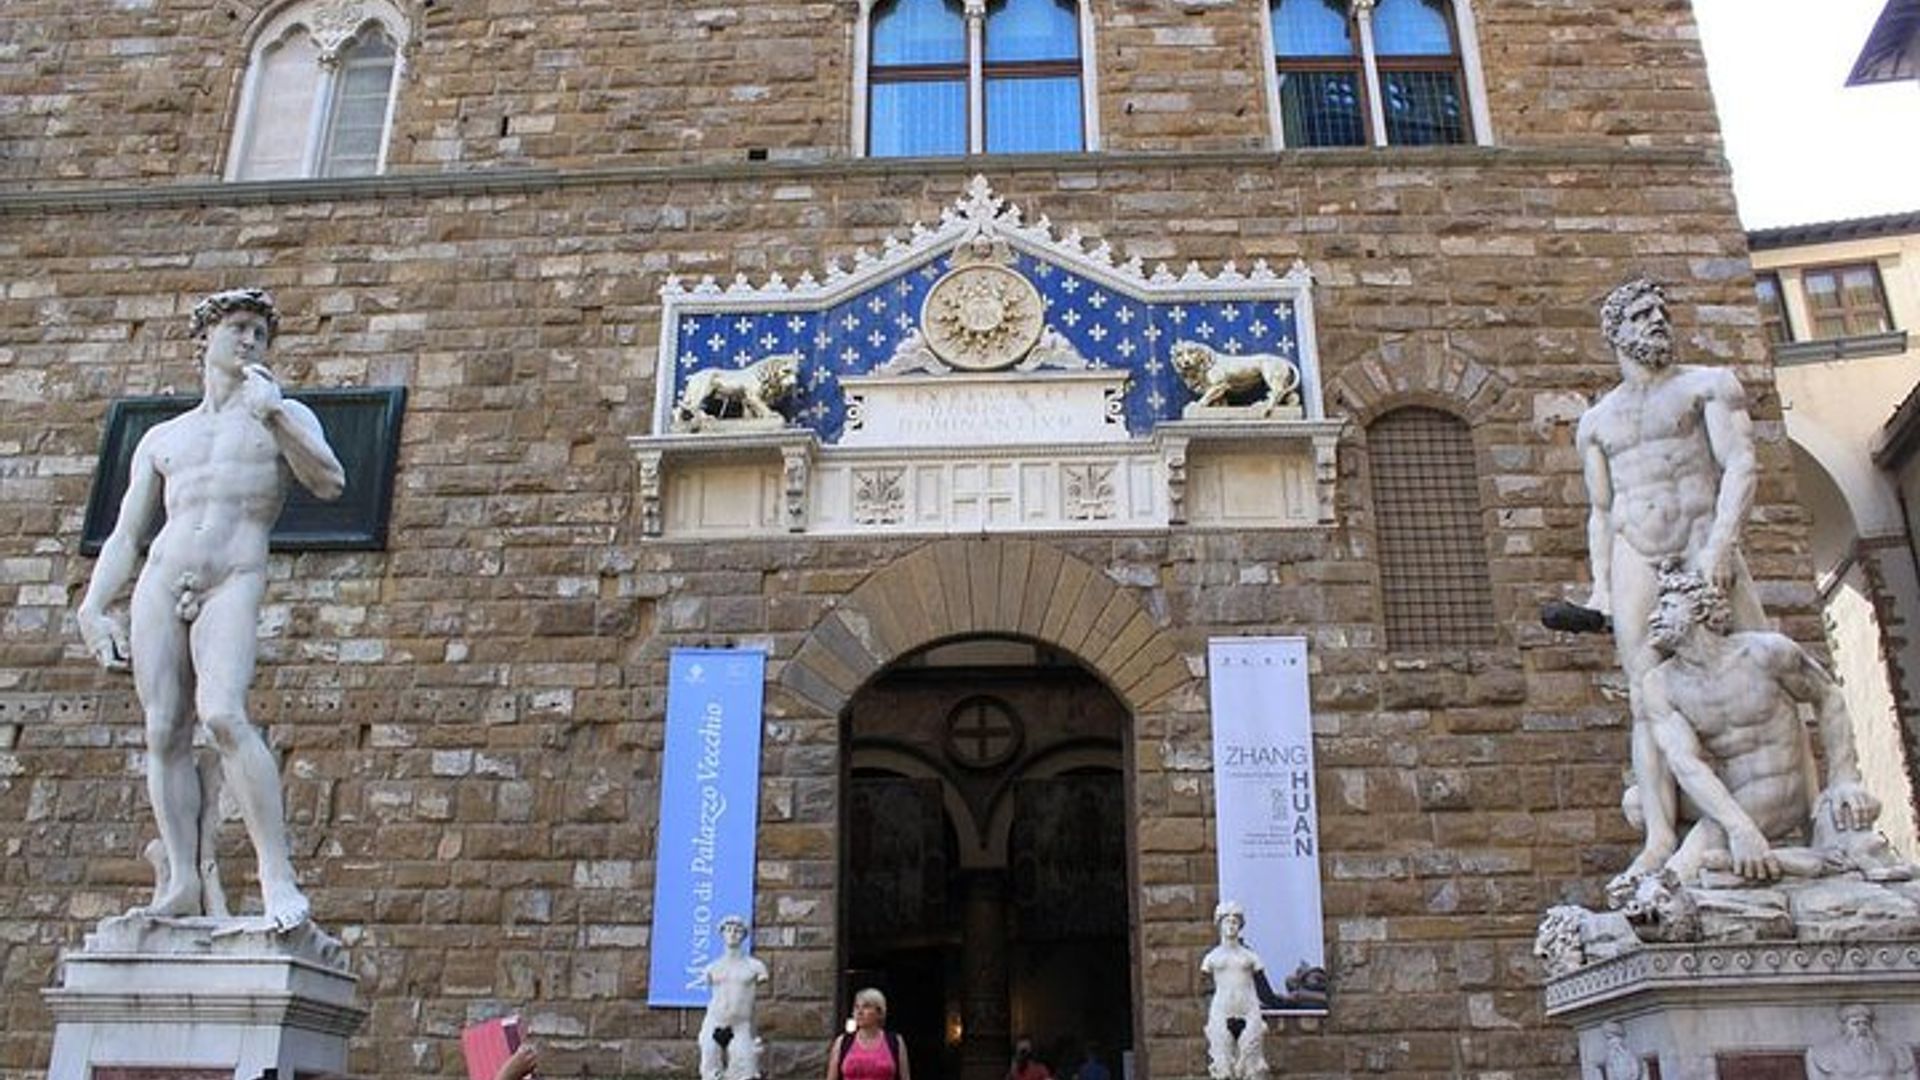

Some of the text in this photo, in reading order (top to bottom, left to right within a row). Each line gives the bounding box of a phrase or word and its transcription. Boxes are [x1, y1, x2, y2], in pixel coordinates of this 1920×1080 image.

[697, 702, 721, 781] Vecchio
[1225, 745, 1308, 766] ZHANG
[691, 785, 727, 875] Palazzo
[1291, 771, 1313, 857] HUAN
[692, 880, 713, 900] di
